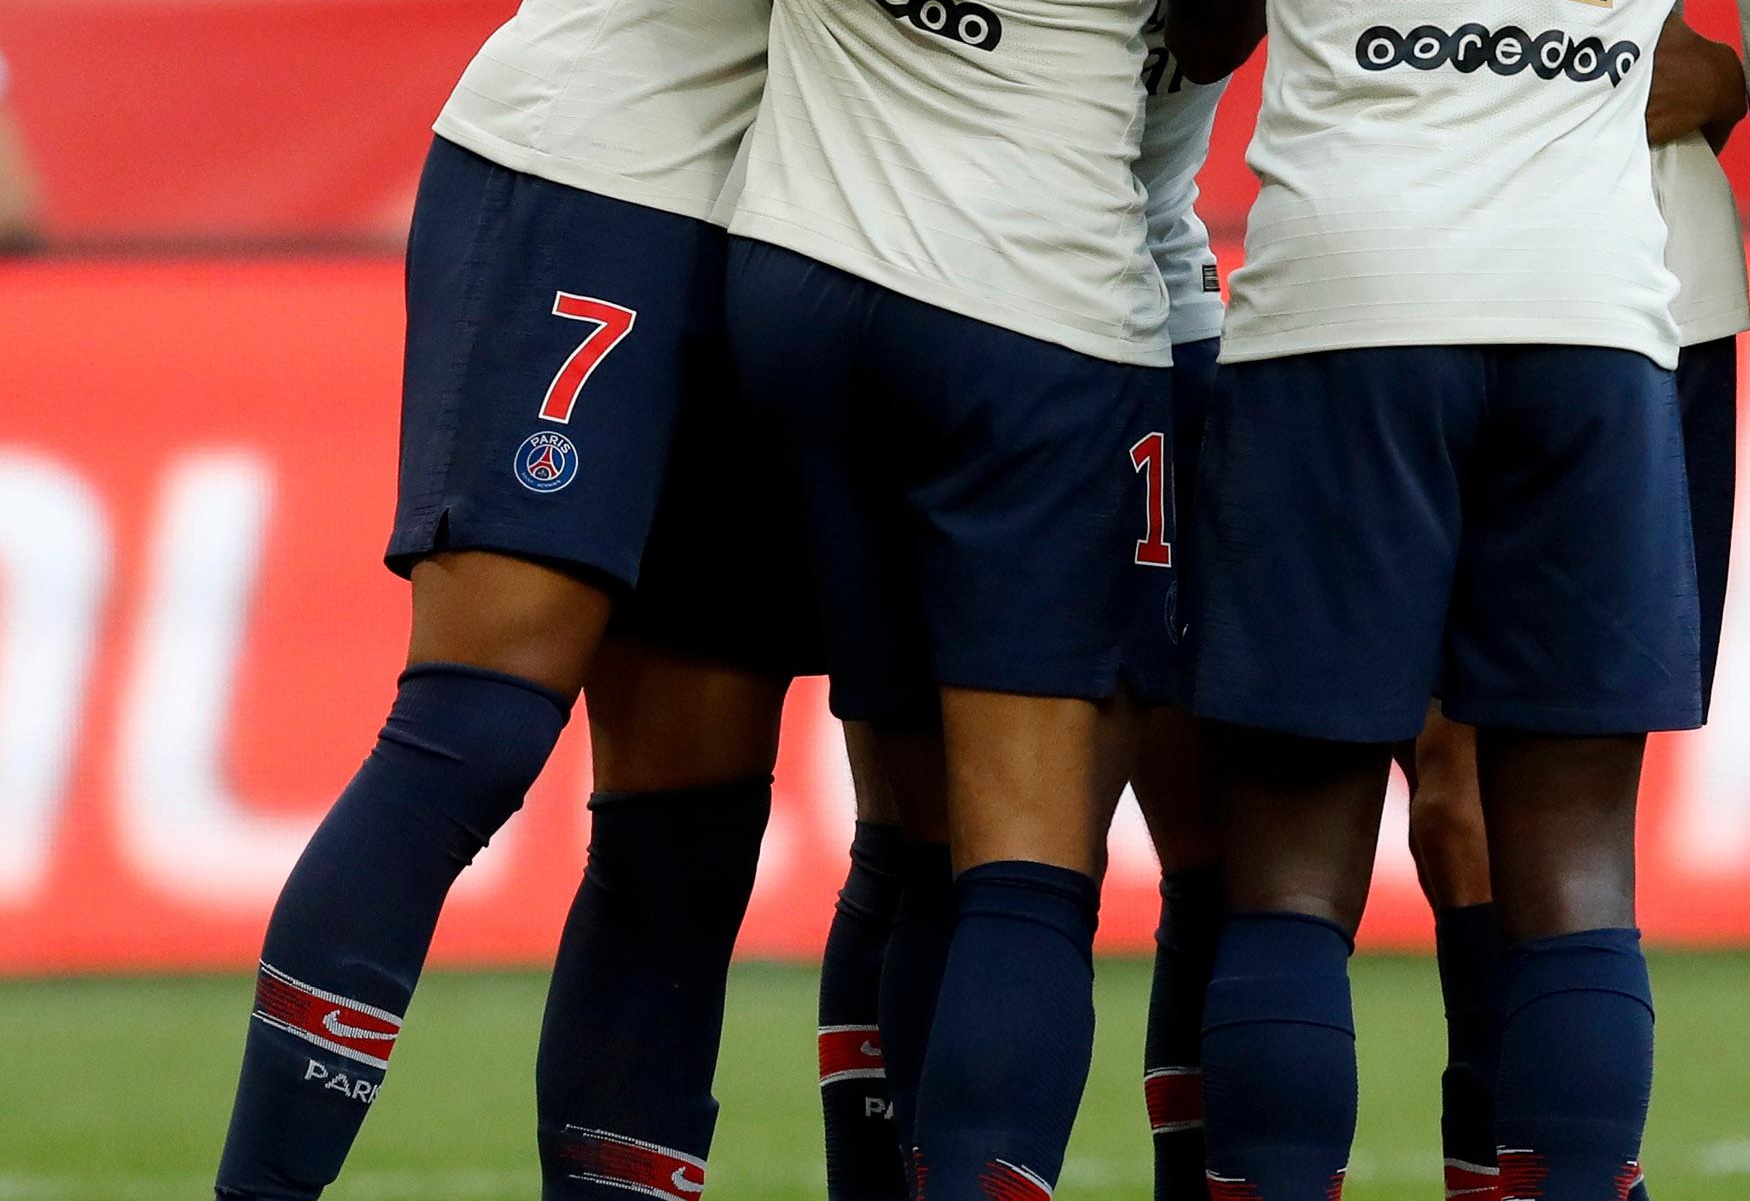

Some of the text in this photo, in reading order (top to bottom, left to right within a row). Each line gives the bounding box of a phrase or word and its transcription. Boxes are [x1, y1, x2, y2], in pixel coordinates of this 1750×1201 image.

[1361, 28, 1639, 82] ooredoo
[538, 290, 637, 424] 7
[530, 434, 571, 454] PARIS
[1129, 431, 1175, 568] 1
[304, 1058, 381, 1104] PARI
